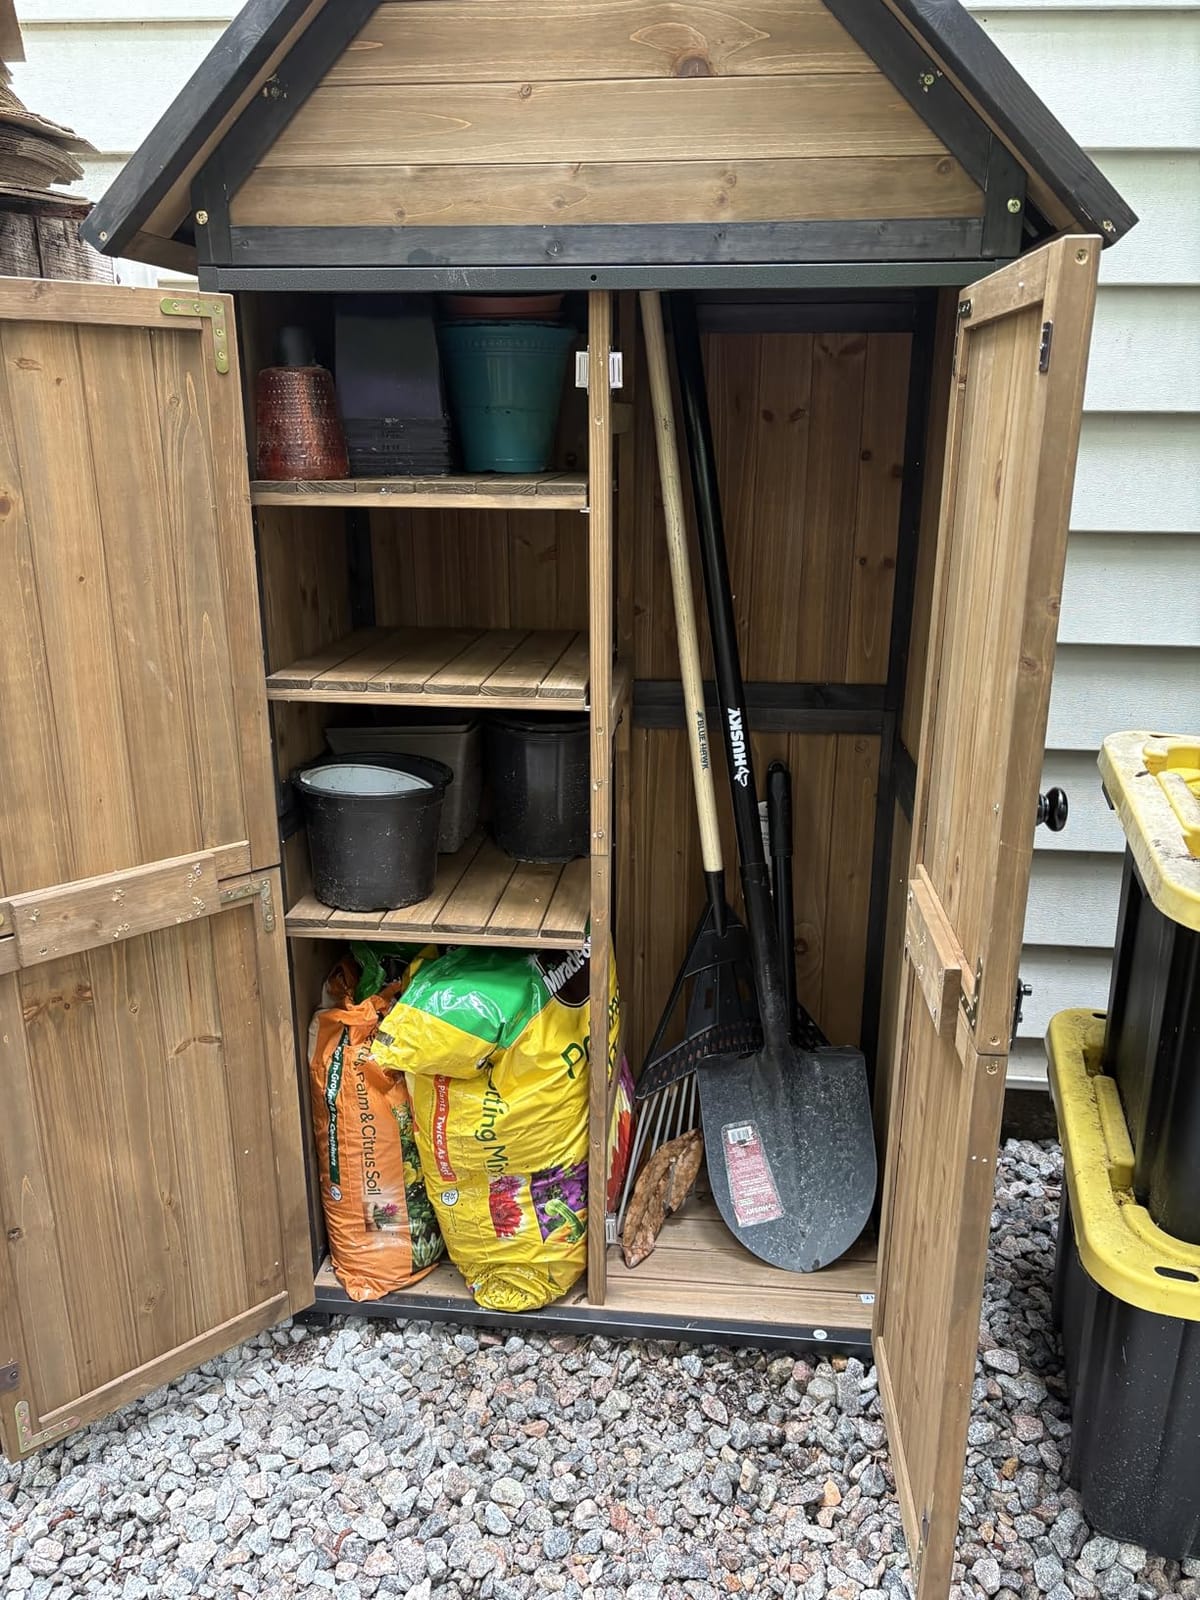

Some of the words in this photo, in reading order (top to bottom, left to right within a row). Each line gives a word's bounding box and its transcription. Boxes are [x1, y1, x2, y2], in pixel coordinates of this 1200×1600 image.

[727, 707, 748, 767] HUSKY
[699, 743, 709, 770] HAWK
[437, 1084, 447, 1112] Plants
[360, 1112, 374, 1124] &
[435, 1115, 447, 1145] Twice
[361, 1125, 377, 1168] Citrus
[483, 1145, 510, 1178] Mix
[366, 1170, 382, 1196] Soil
